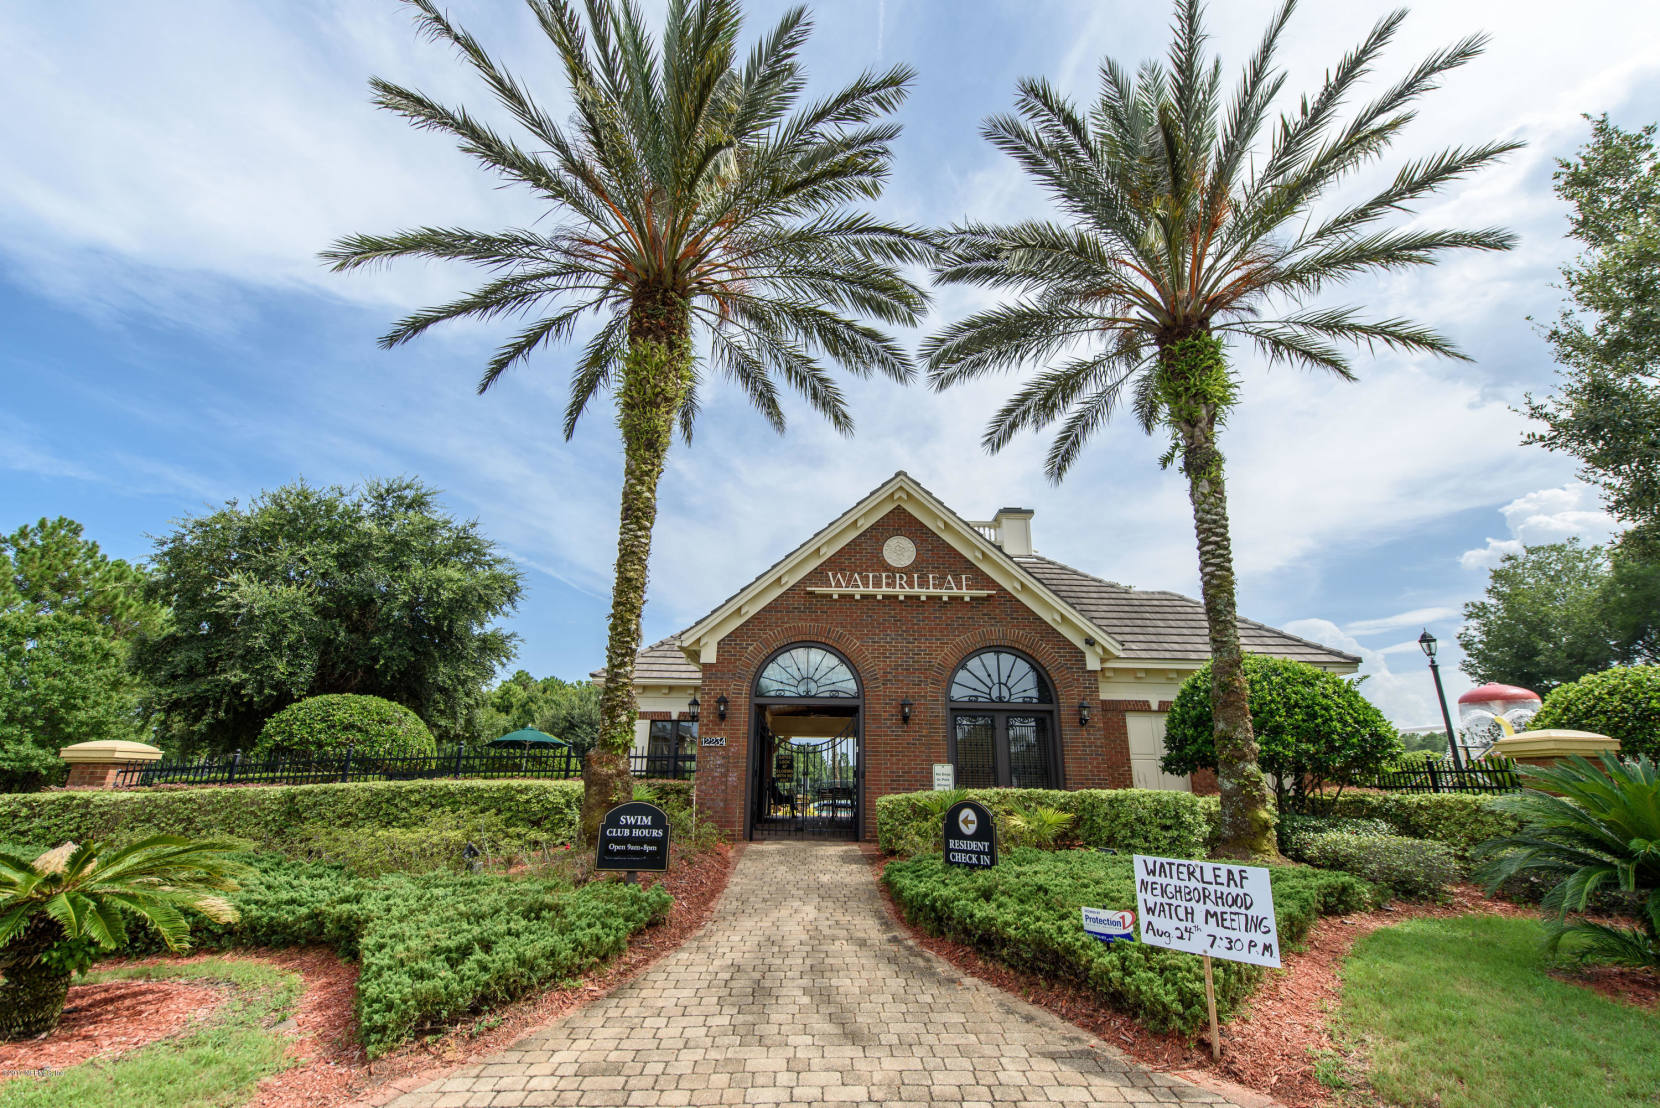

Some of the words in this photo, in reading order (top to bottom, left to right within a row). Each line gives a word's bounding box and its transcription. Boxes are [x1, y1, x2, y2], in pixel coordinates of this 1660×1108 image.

[828, 571, 972, 592] WATERLEAF
[702, 736, 726, 747] 12234
[620, 815, 652, 825] SWIM
[606, 828, 630, 836] CLUB
[632, 829, 663, 837] HOURS
[608, 843, 626, 852] Open
[949, 840, 990, 852] RESIDENT
[949, 852, 978, 864] CHECK
[980, 855, 990, 866] IN
[1143, 859, 1249, 889] WATERLEAF
[1139, 878, 1253, 911] NEIGHBORHOOD
[1084, 914, 1122, 928] Protection
[1144, 898, 1195, 923] WATCH
[1204, 908, 1271, 935] MEETING
[1206, 933, 1244, 952] 7:30
